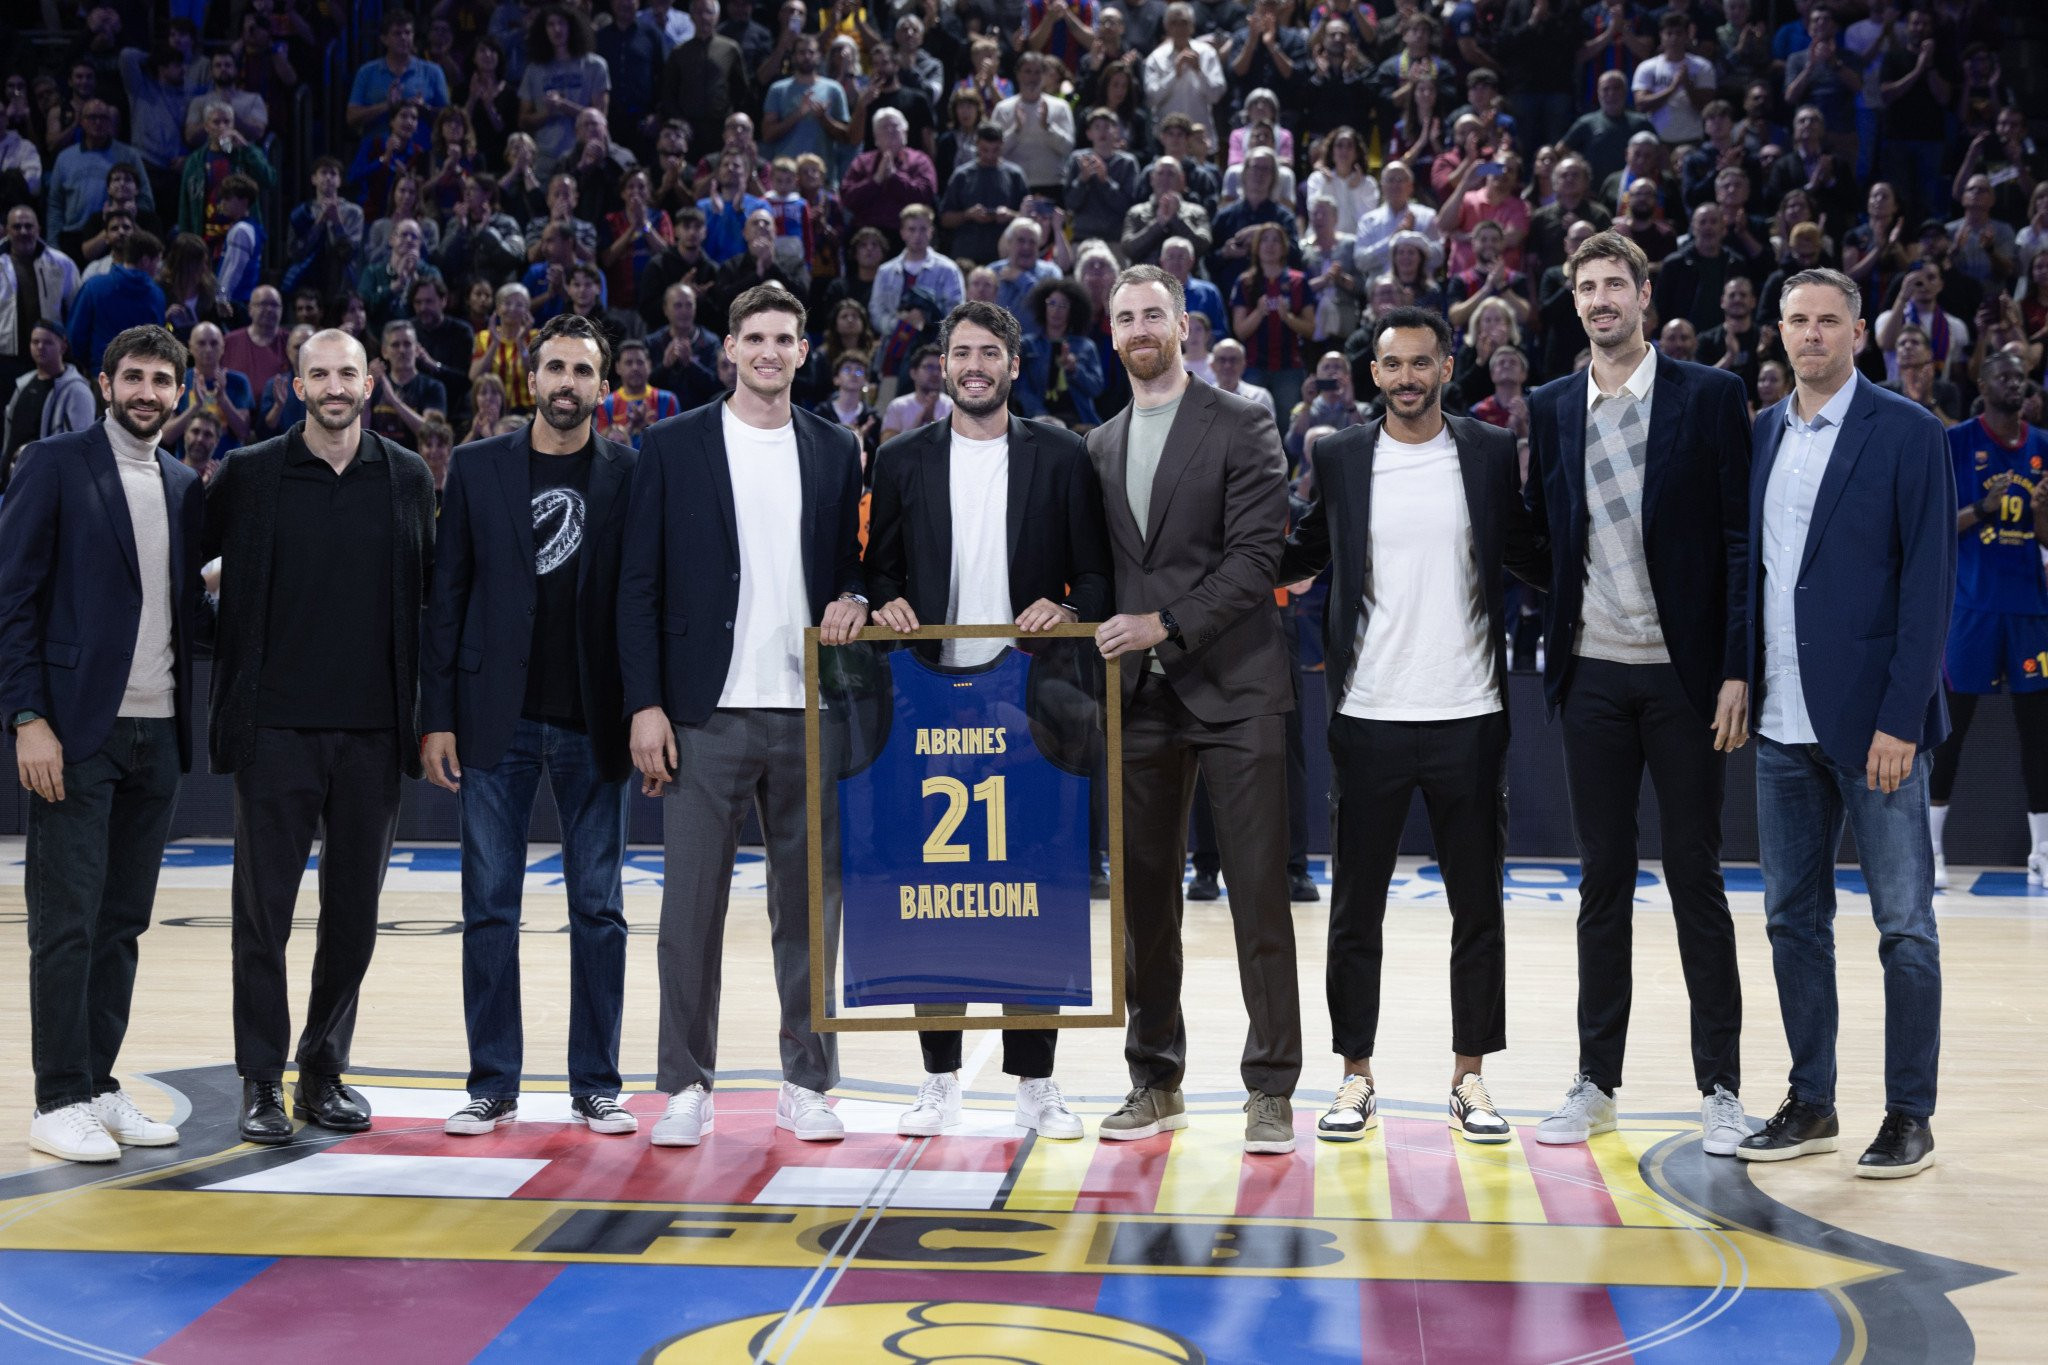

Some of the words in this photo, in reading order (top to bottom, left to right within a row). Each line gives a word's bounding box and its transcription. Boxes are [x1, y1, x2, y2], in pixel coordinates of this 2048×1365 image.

[2001, 495, 2023, 522] 19
[915, 727, 1006, 755] ABRINES
[922, 775, 1007, 863] 21
[900, 882, 1039, 920] BARCELONA
